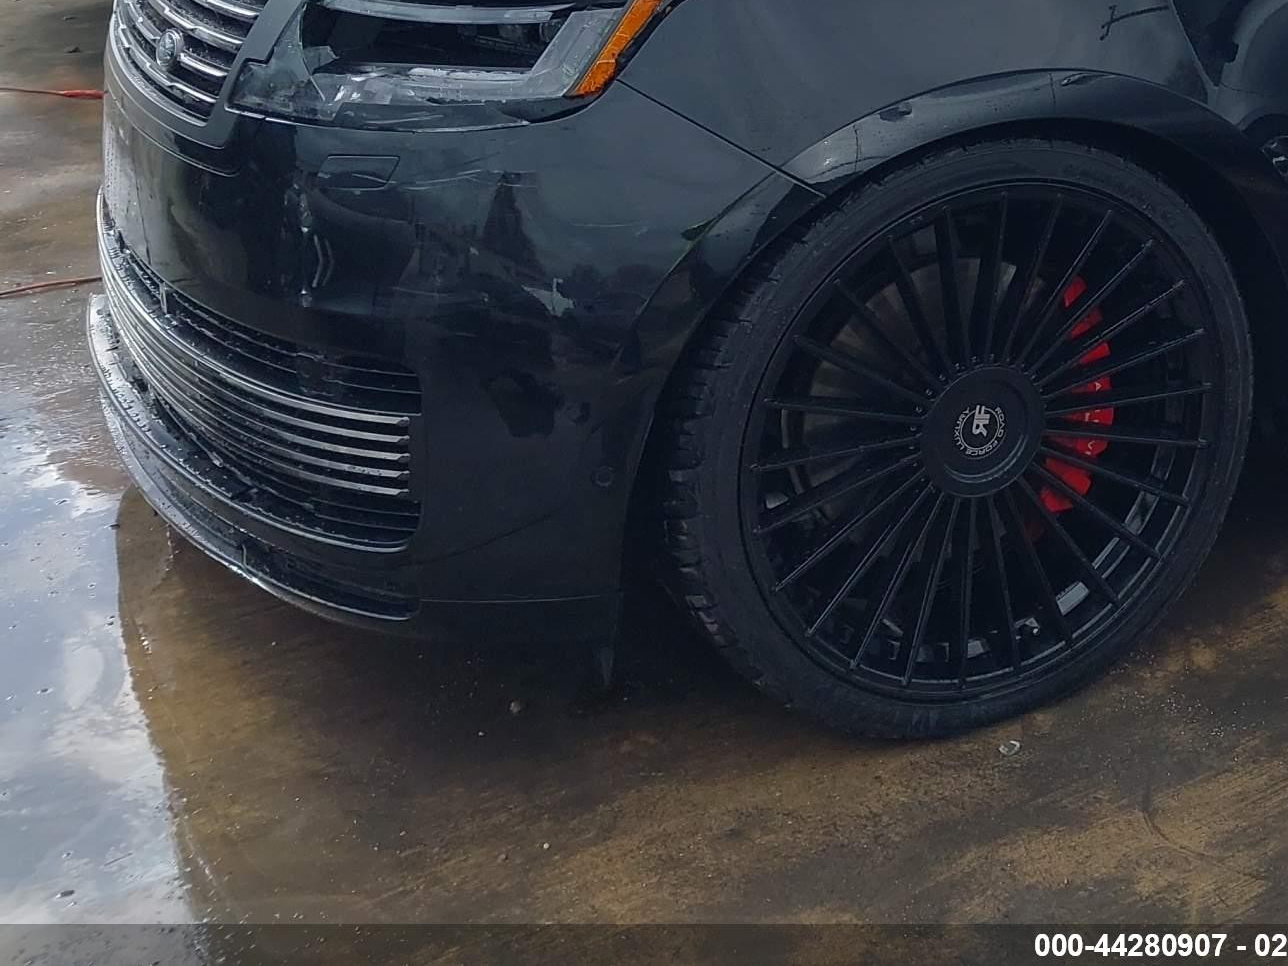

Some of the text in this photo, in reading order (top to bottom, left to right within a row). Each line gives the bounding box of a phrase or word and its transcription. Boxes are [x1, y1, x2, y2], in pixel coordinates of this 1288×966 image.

[953, 407, 1006, 456] ROAD FORCE LUXURY
